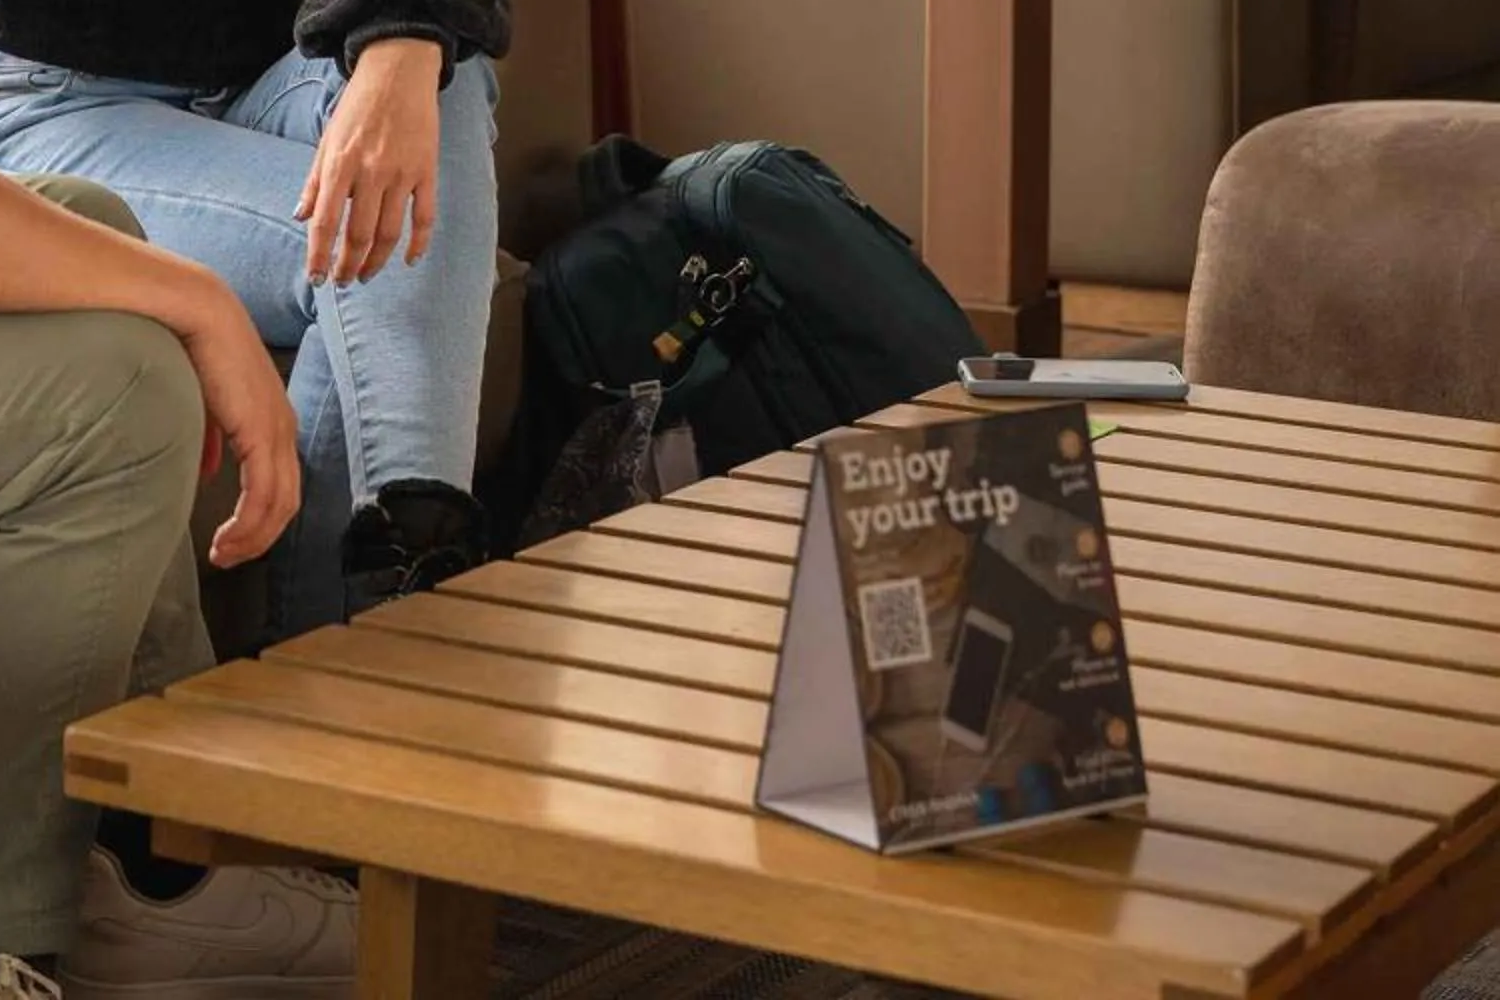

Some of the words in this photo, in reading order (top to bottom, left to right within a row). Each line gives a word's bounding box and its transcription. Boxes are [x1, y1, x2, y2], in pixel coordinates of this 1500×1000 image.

[840, 446, 951, 494] Enjoy
[847, 497, 939, 547] your
[946, 478, 1019, 525] trip
